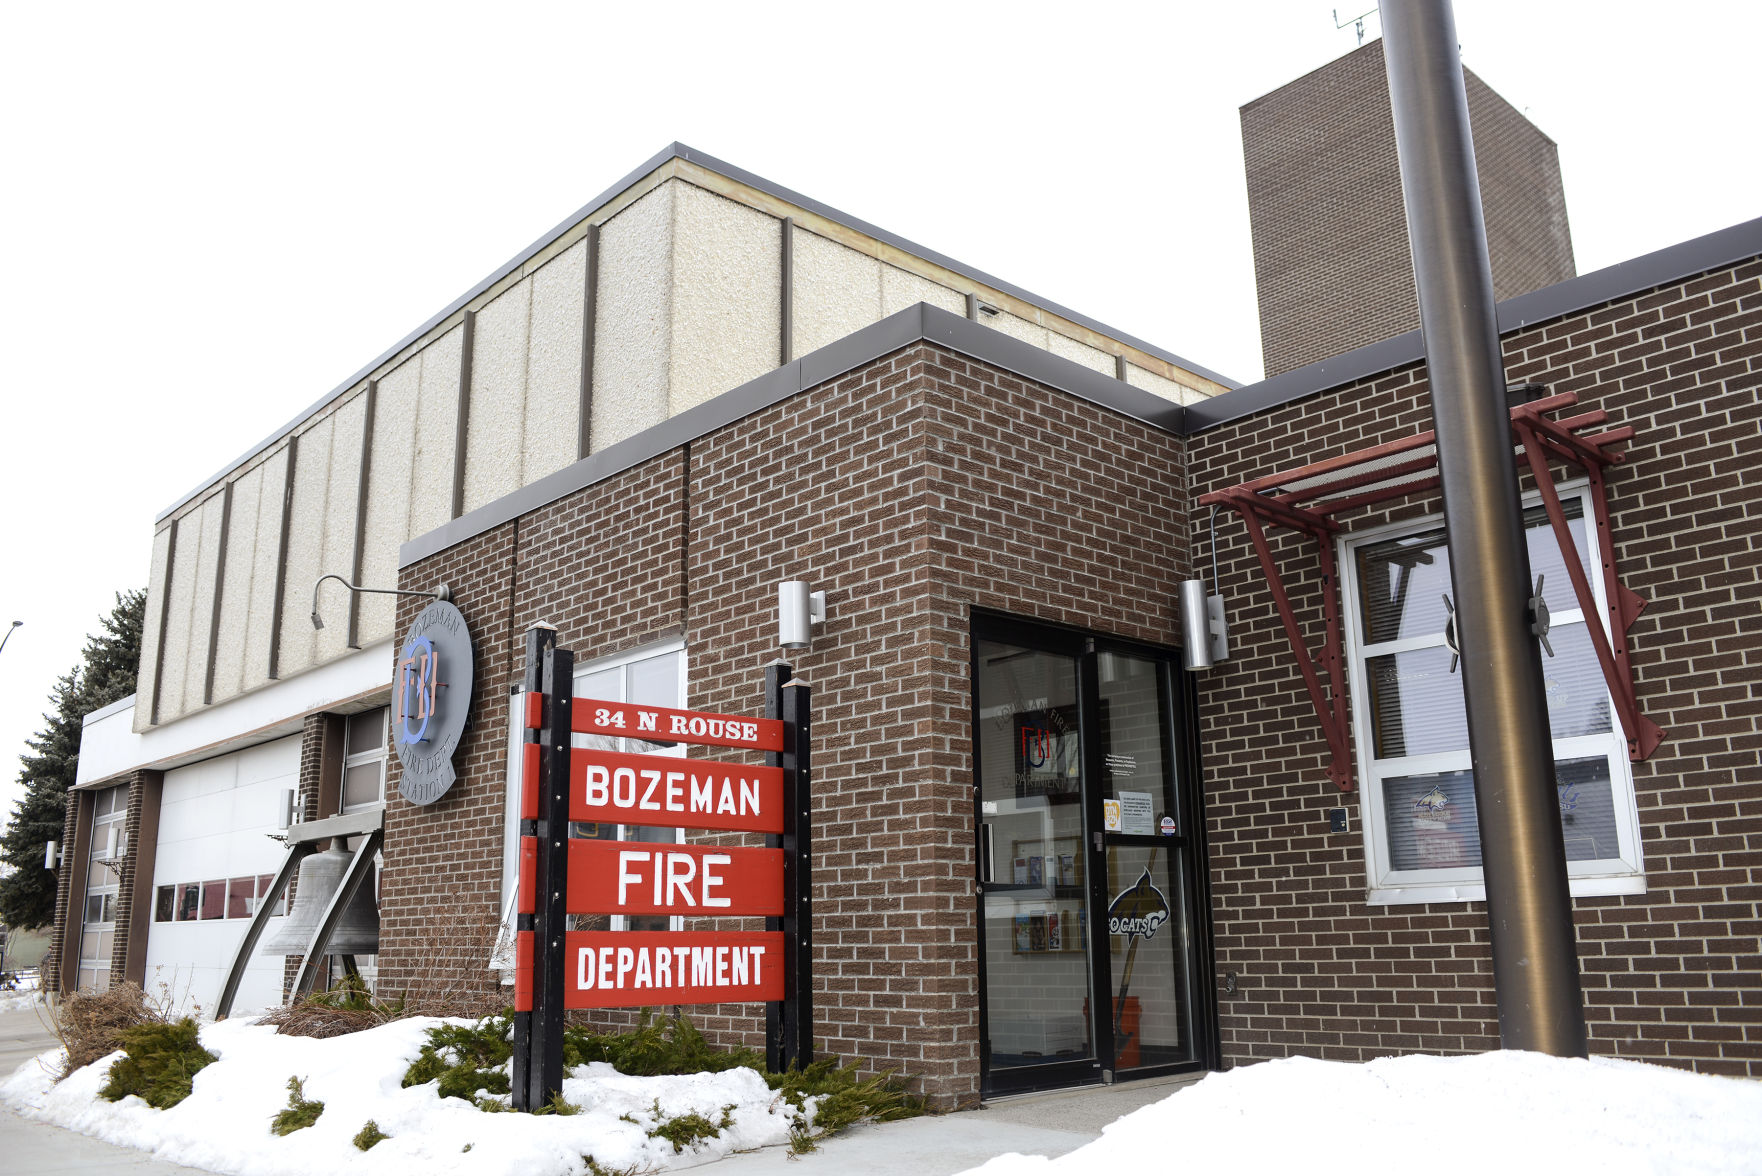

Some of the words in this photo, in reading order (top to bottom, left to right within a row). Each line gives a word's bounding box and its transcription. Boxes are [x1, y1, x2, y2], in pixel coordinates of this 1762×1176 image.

[407, 607, 460, 646] BOZEMAN
[594, 708, 626, 729] 34
[669, 714, 758, 741] ROUSE
[401, 738, 424, 775] FIRE
[400, 772, 445, 801] STATION
[585, 765, 760, 816] BOZEMAN
[1002, 772, 1067, 789] DPARTMENT
[618, 850, 732, 908] FIRE
[1109, 917, 1119, 932] O
[577, 946, 766, 991] DEPARTMENT
